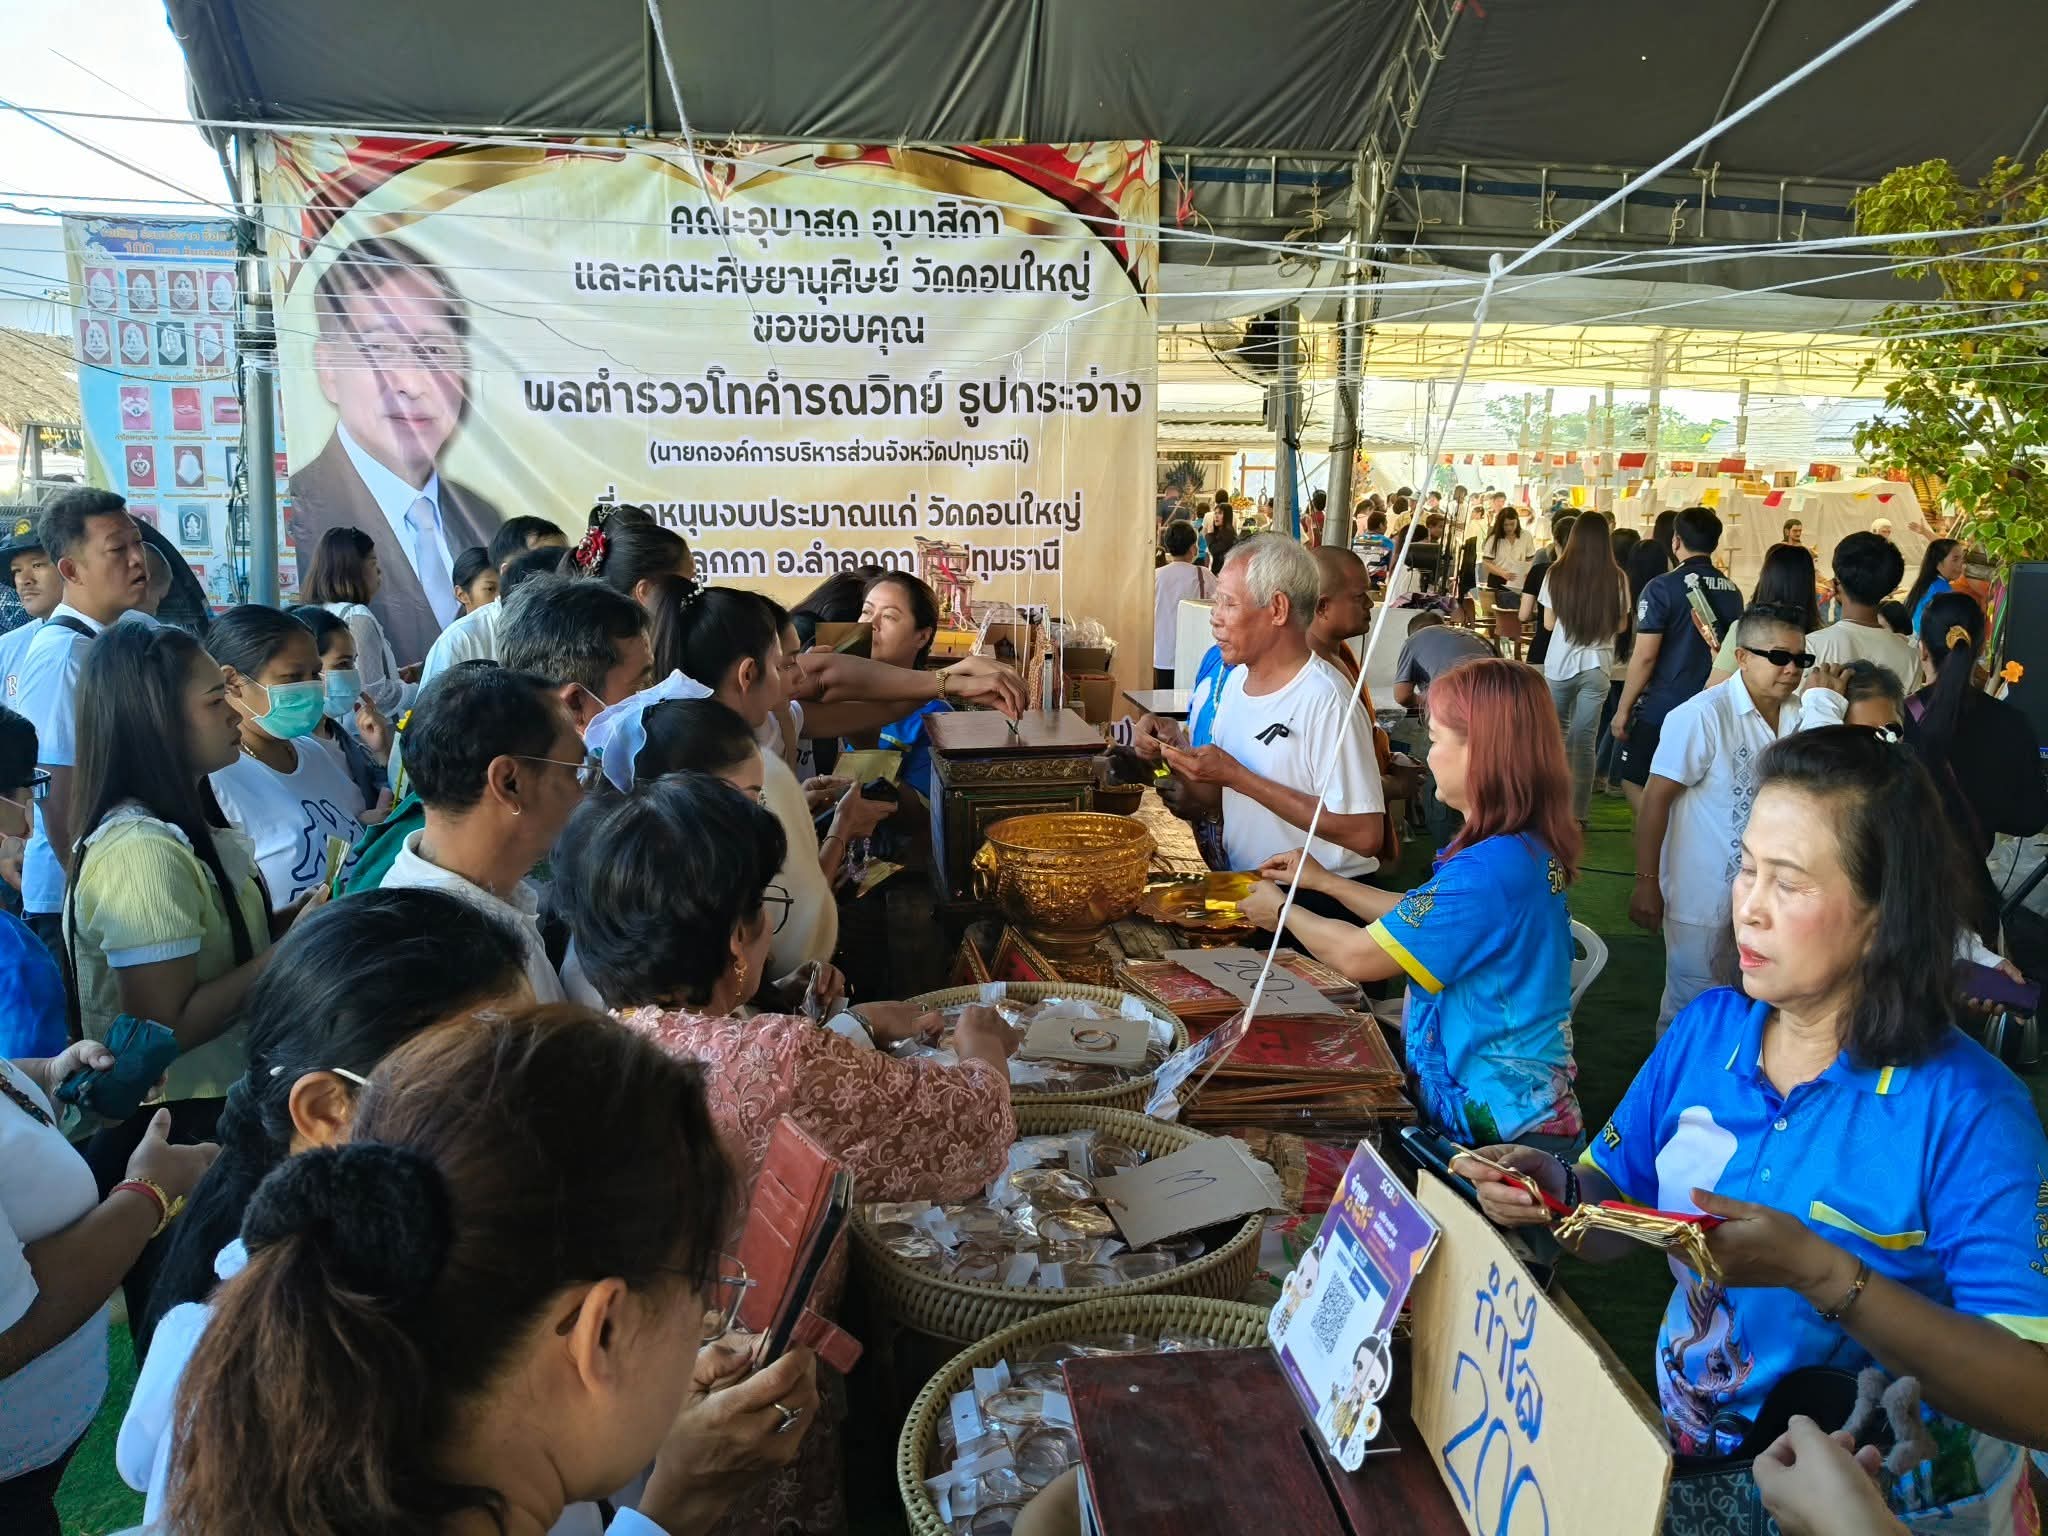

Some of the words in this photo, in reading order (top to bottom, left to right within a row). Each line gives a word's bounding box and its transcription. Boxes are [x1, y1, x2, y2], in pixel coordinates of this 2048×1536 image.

[671, 205, 858, 249] คณะอุบาสก
[872, 201, 1000, 250] อุบาสิกา
[912, 249, 1090, 301] วัดดอนใหญ่
[753, 313, 924, 355] ขอขอบคุณ
[524, 365, 943, 416] พลตำรวจโทคำรณวิทย์
[959, 366, 1143, 427] ธูปกระจ่าง
[650, 438, 1030, 467] (นายกองค์การบริหารส่วนจังหวัดปทุมธานี)
[928, 491, 1081, 532] วัดดอนใหญ่
[1379, 1178, 1396, 1200] SCB
